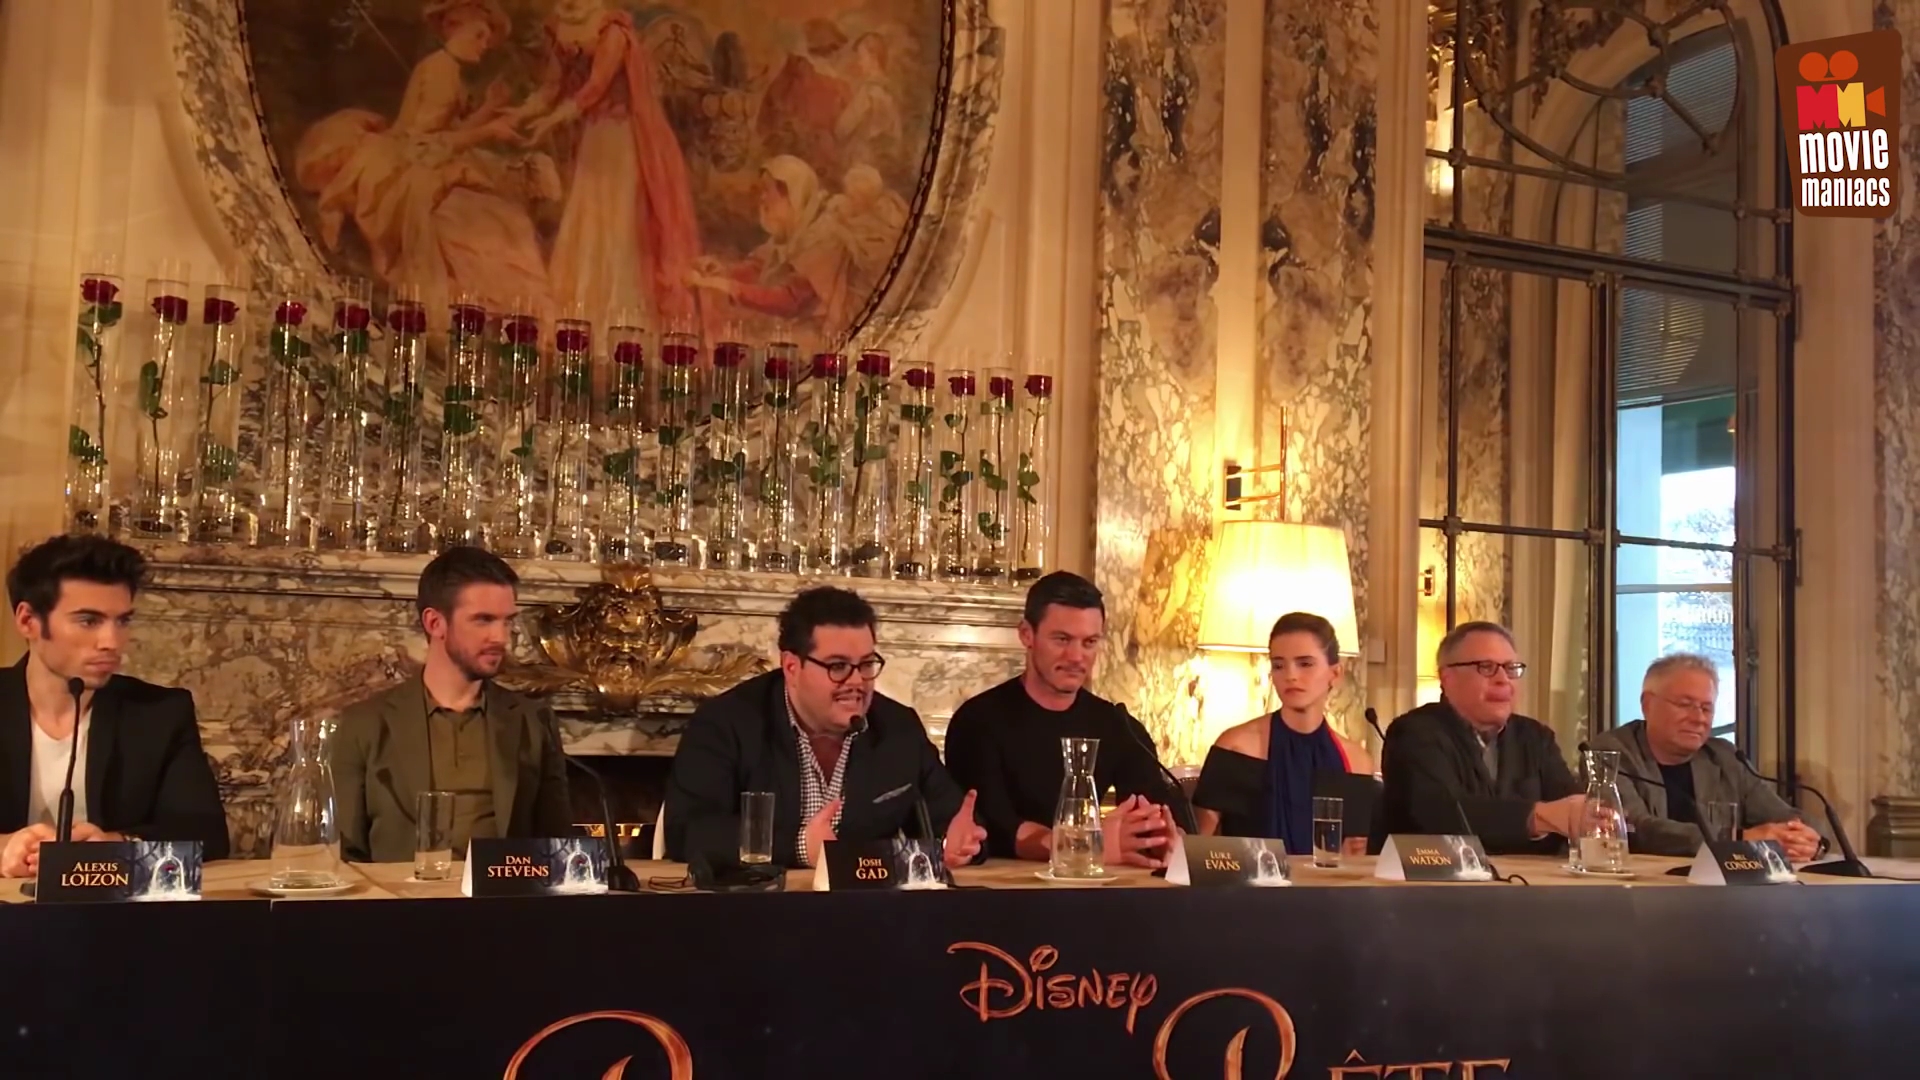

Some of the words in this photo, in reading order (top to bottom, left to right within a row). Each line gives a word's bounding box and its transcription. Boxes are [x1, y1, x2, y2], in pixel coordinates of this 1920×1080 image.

[505, 855, 531, 865] DAN
[1209, 850, 1232, 860] LUKE
[1409, 855, 1452, 866] WATSON
[72, 861, 119, 872] ALEXIS
[857, 857, 882, 867] JOSH
[1204, 859, 1240, 871] EVANS
[1724, 860, 1764, 871] CONDON
[487, 865, 550, 878] STEVENS
[855, 867, 889, 879] GAD
[61, 873, 129, 887] LOIZON
